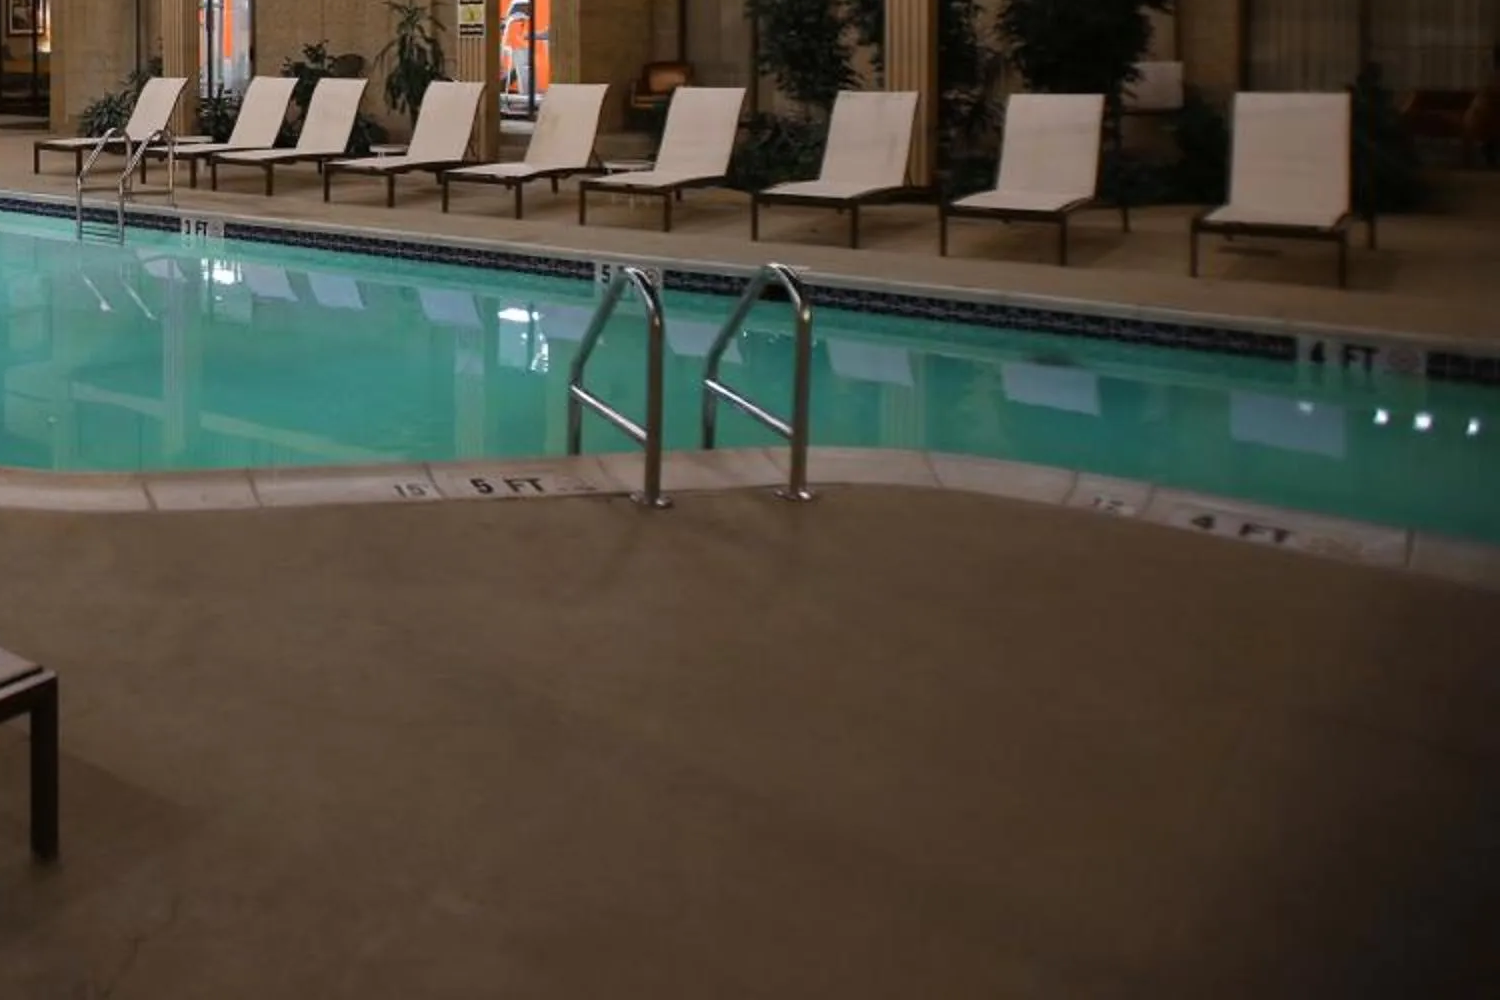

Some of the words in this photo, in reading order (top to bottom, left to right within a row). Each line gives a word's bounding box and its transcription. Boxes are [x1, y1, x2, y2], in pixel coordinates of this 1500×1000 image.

[195, 220, 208, 236] FT
[602, 264, 611, 283] 5
[1340, 342, 1380, 373] FT
[470, 478, 494, 494] 5
[503, 478, 544, 493] FT
[1239, 522, 1289, 543] FT
